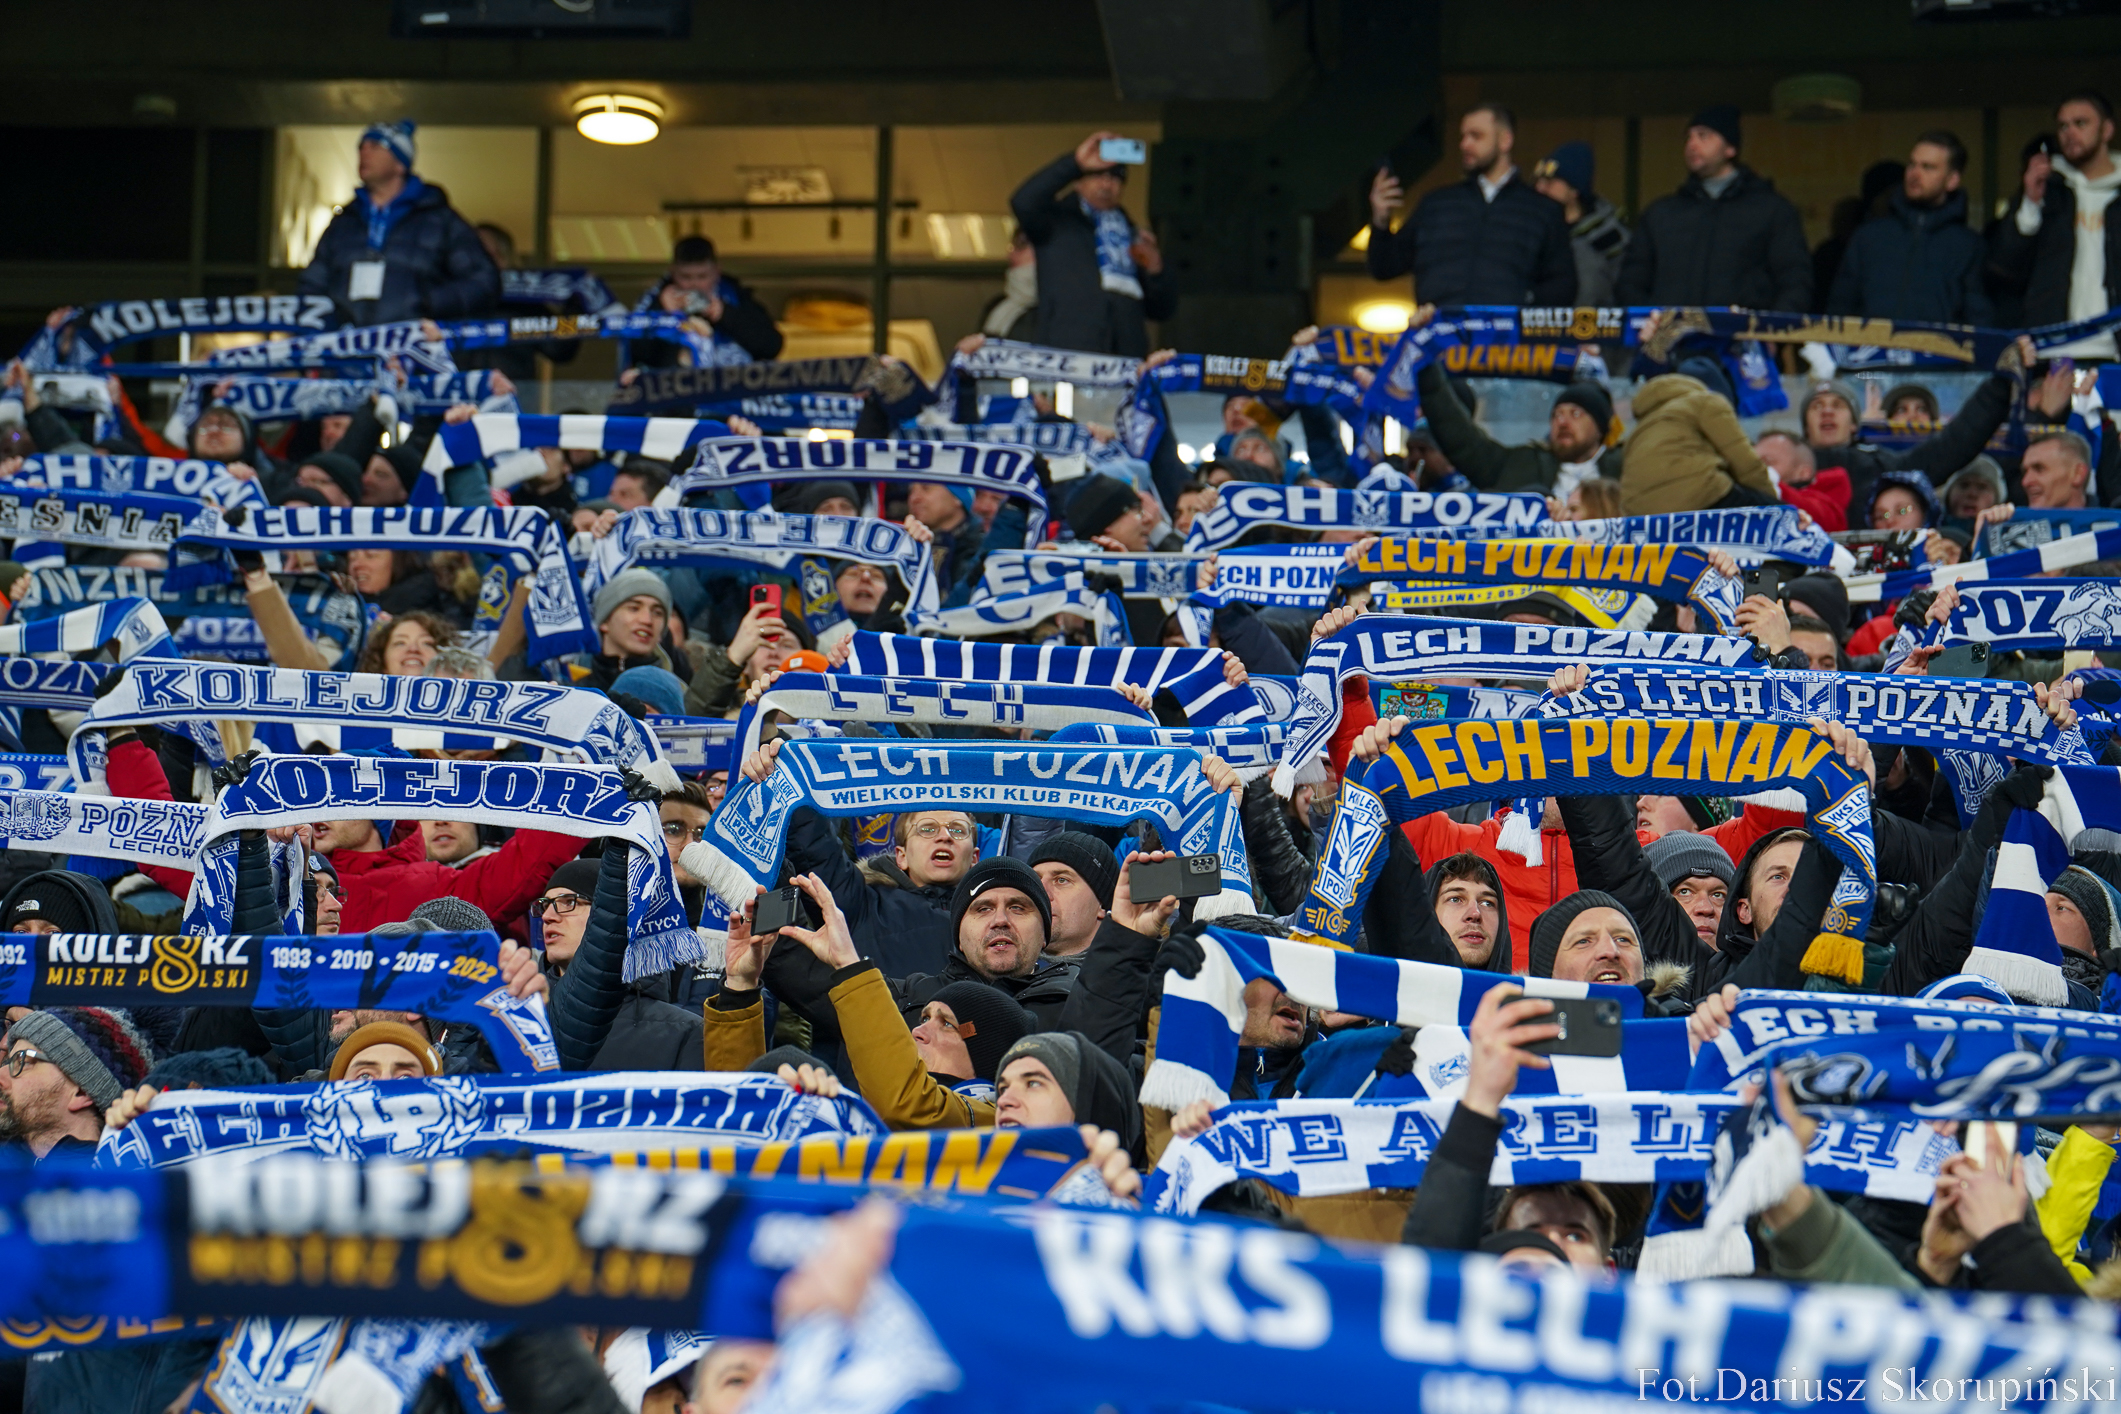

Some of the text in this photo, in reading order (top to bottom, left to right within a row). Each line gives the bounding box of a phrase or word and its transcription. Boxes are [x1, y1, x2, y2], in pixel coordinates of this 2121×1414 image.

[90, 295, 334, 343] KOLEJORZ
[1334, 329, 1398, 366] LEC
[644, 364, 718, 398] LECH
[228, 506, 353, 538] ECH
[1402, 490, 1542, 526] POZN
[1402, 592, 1475, 605] WARSZAWA
[1357, 625, 1482, 673] LECH
[132, 665, 571, 735] KOLEJORZ
[823, 673, 1024, 725] LECH
[1538, 678, 1627, 719] KKS
[1634, 679, 1765, 716] LECH
[1846, 684, 2051, 740] POZNAN
[798, 743, 950, 783] LECH
[1394, 720, 1547, 799] LECH
[221, 757, 636, 825] KOLEJORZ
[779, 777, 794, 798] LECH
[831, 786, 996, 805] WIELKOPOLSKI
[1003, 787, 1061, 803] KLUB
[79, 802, 209, 848] POZN
[1828, 804, 1853, 823] KKS
[47, 967, 125, 987] MISTRZ
[271, 947, 311, 969] 1993
[330, 949, 373, 970] 2010
[392, 952, 439, 973] 2015
[448, 955, 498, 984] 2022
[1193, 1113, 1348, 1168] WE
[1034, 1212, 1332, 1350] KKS
[1381, 1243, 1732, 1393] LECH
